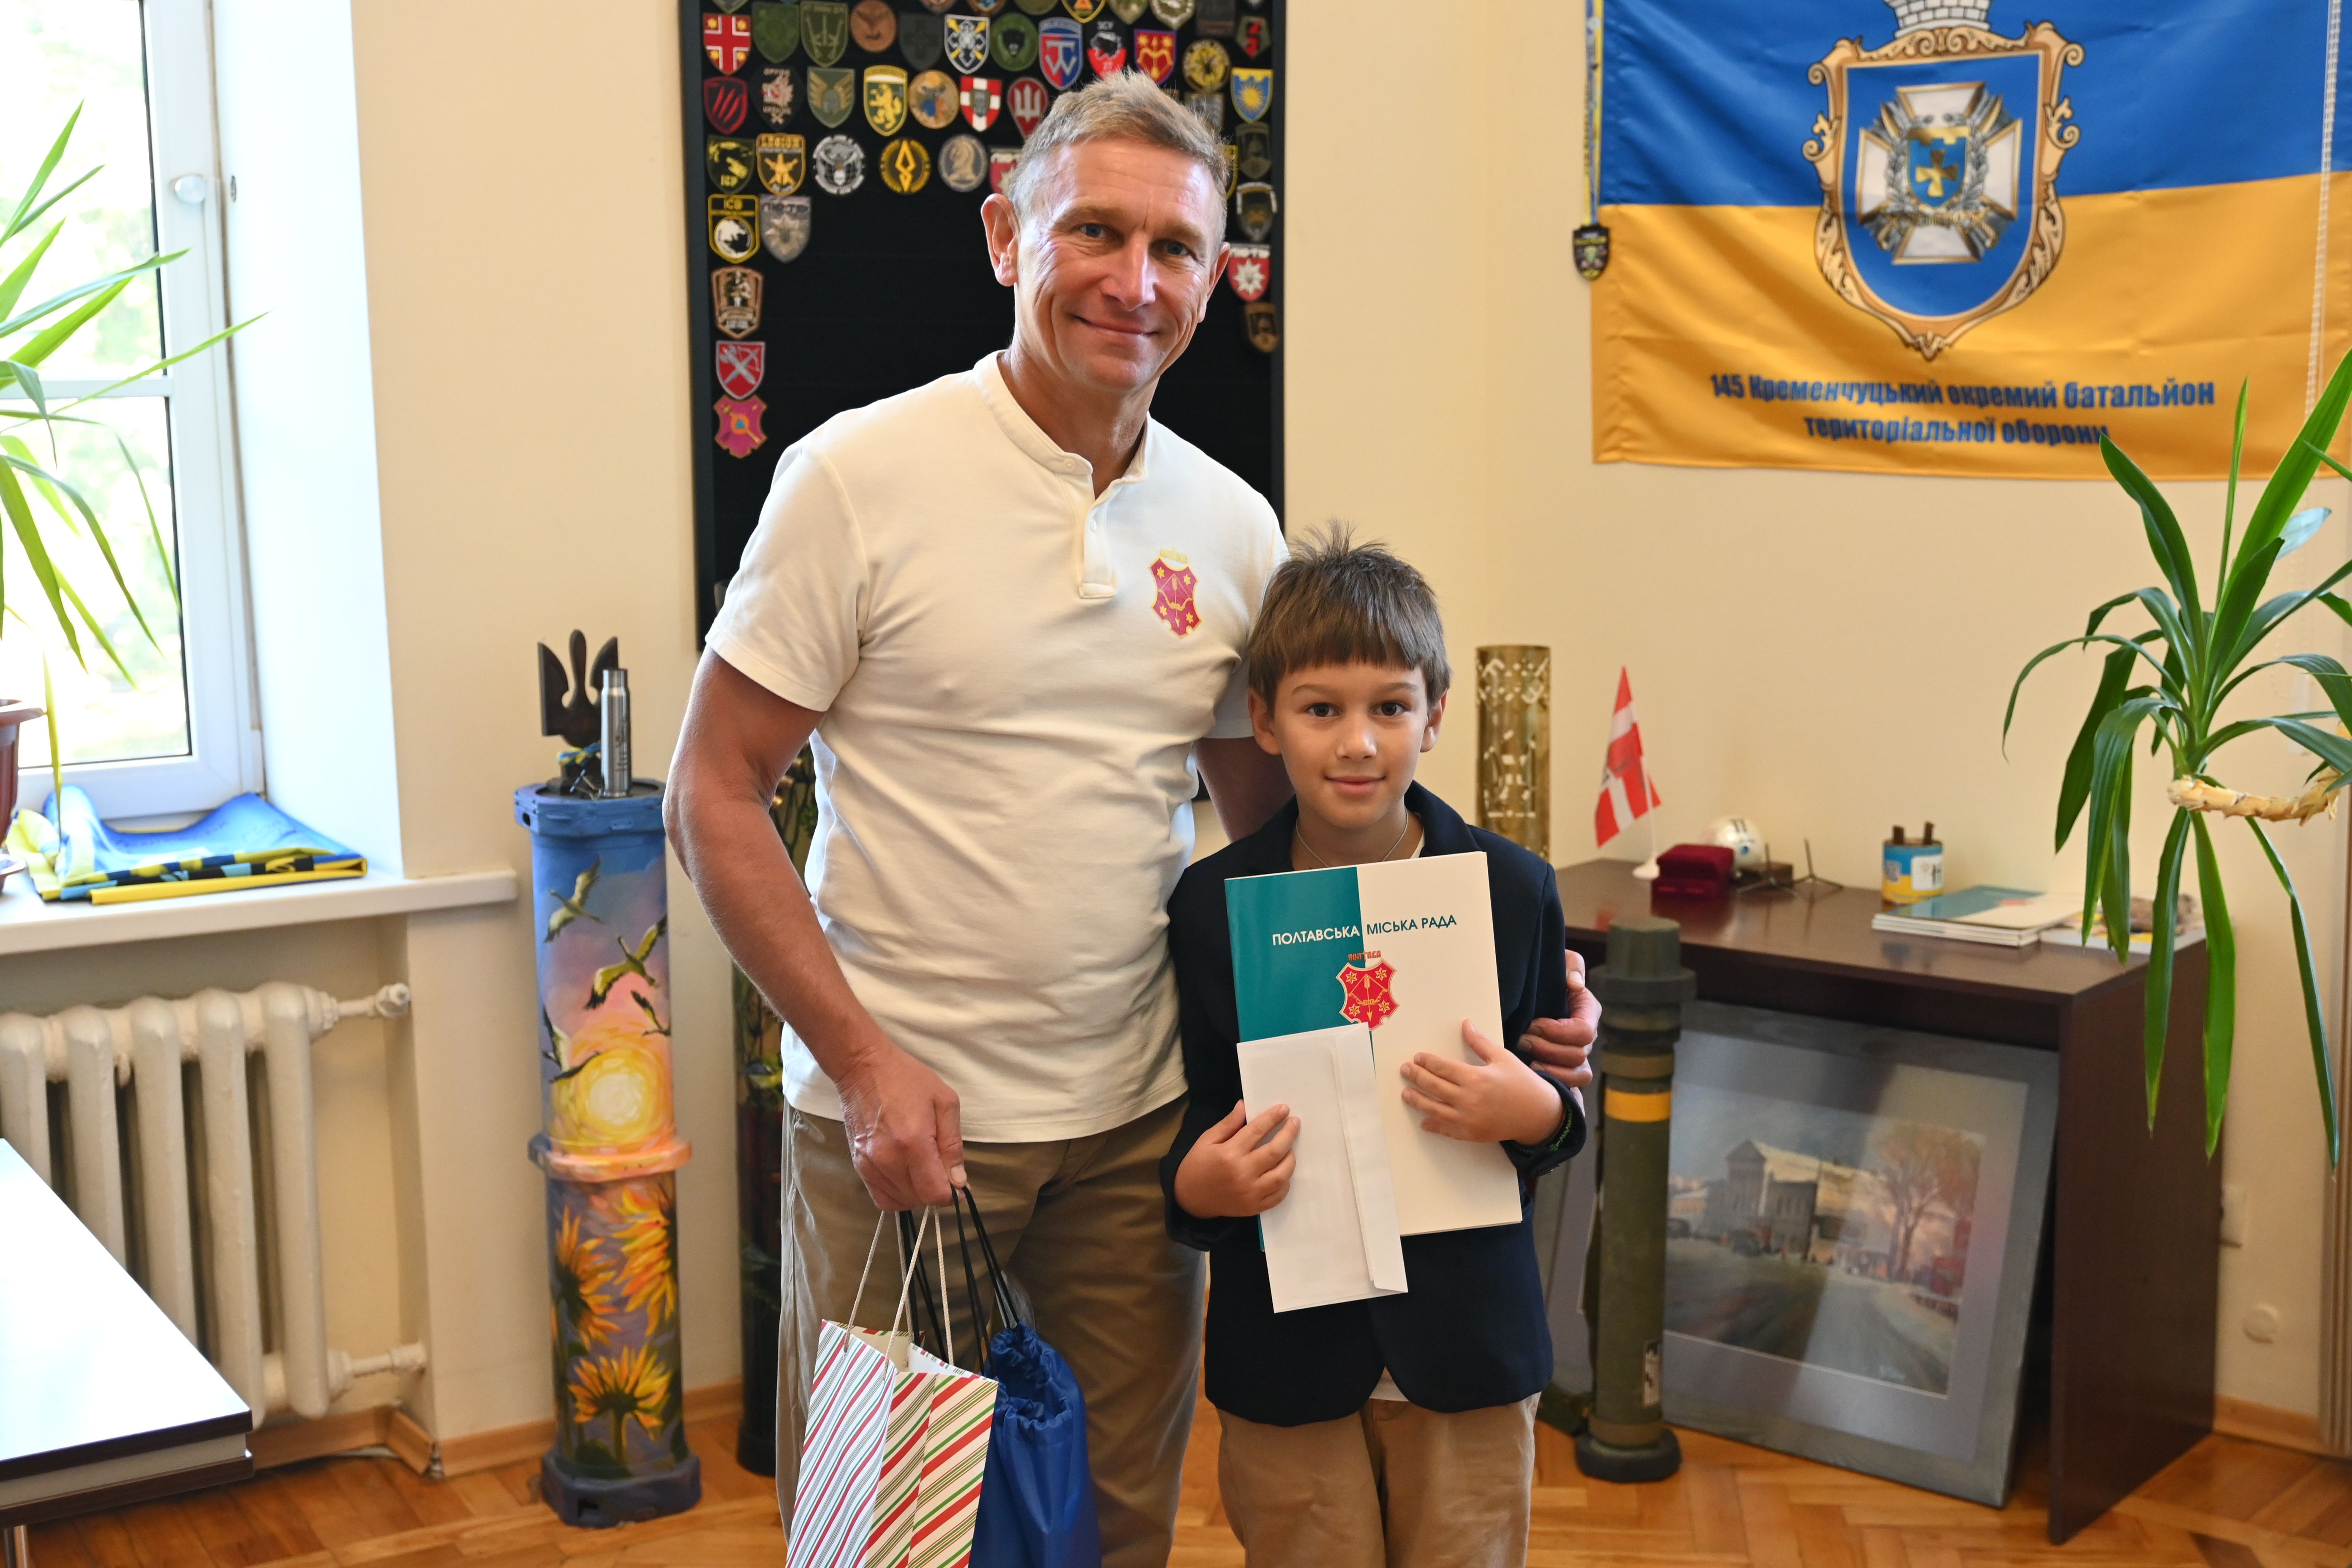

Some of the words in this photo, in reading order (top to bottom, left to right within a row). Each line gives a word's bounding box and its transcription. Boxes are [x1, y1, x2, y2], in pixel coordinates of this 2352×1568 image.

[1711, 374, 1745, 398] 145
[1749, 375, 1943, 406] Кременчуцький
[1947, 381, 2058, 408] окремий
[2063, 378, 2215, 408] батальйон
[1803, 416, 1995, 443] територіальної
[2001, 419, 2110, 446] оборони
[1272, 925, 1360, 946] ПОЛТАВСЬКА
[1367, 919, 1418, 935] МІСЬКА
[1421, 914, 1457, 929] РАДА
